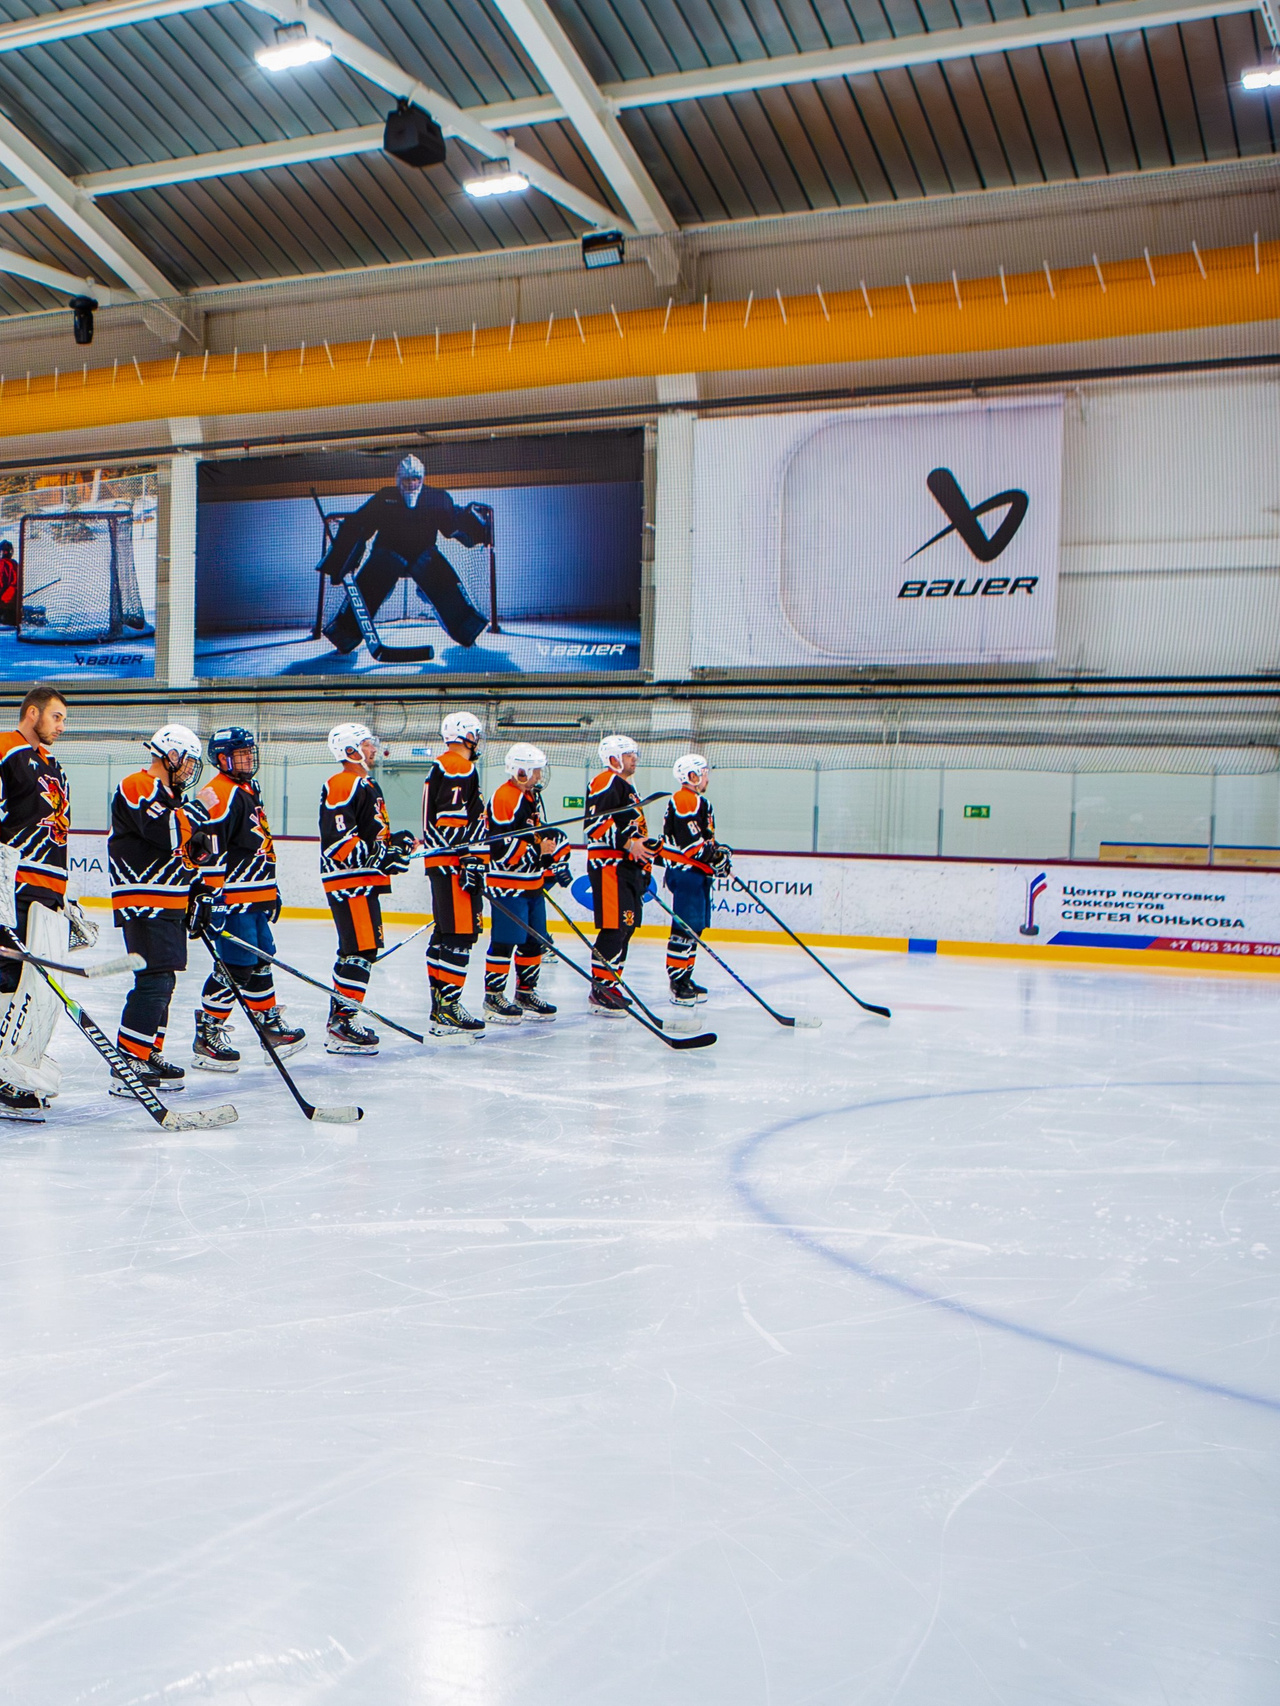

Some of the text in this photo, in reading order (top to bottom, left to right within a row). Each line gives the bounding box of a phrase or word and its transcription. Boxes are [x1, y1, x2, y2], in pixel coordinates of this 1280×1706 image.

[897, 576, 1039, 598] BAUER
[347, 585, 379, 645] BAUER
[551, 644, 626, 656] BAUER
[86, 654, 144, 666] BAUER
[334, 814, 347, 832] 8
[1062, 886, 1226, 902] Центр подготовки
[1062, 899, 1165, 910] хоккеистов
[1061, 911, 1245, 928] СЕРГЕЯ КОНЬКОВА
[11, 992, 32, 1046] CCM
[84, 1025, 163, 1113] WARRIOR
